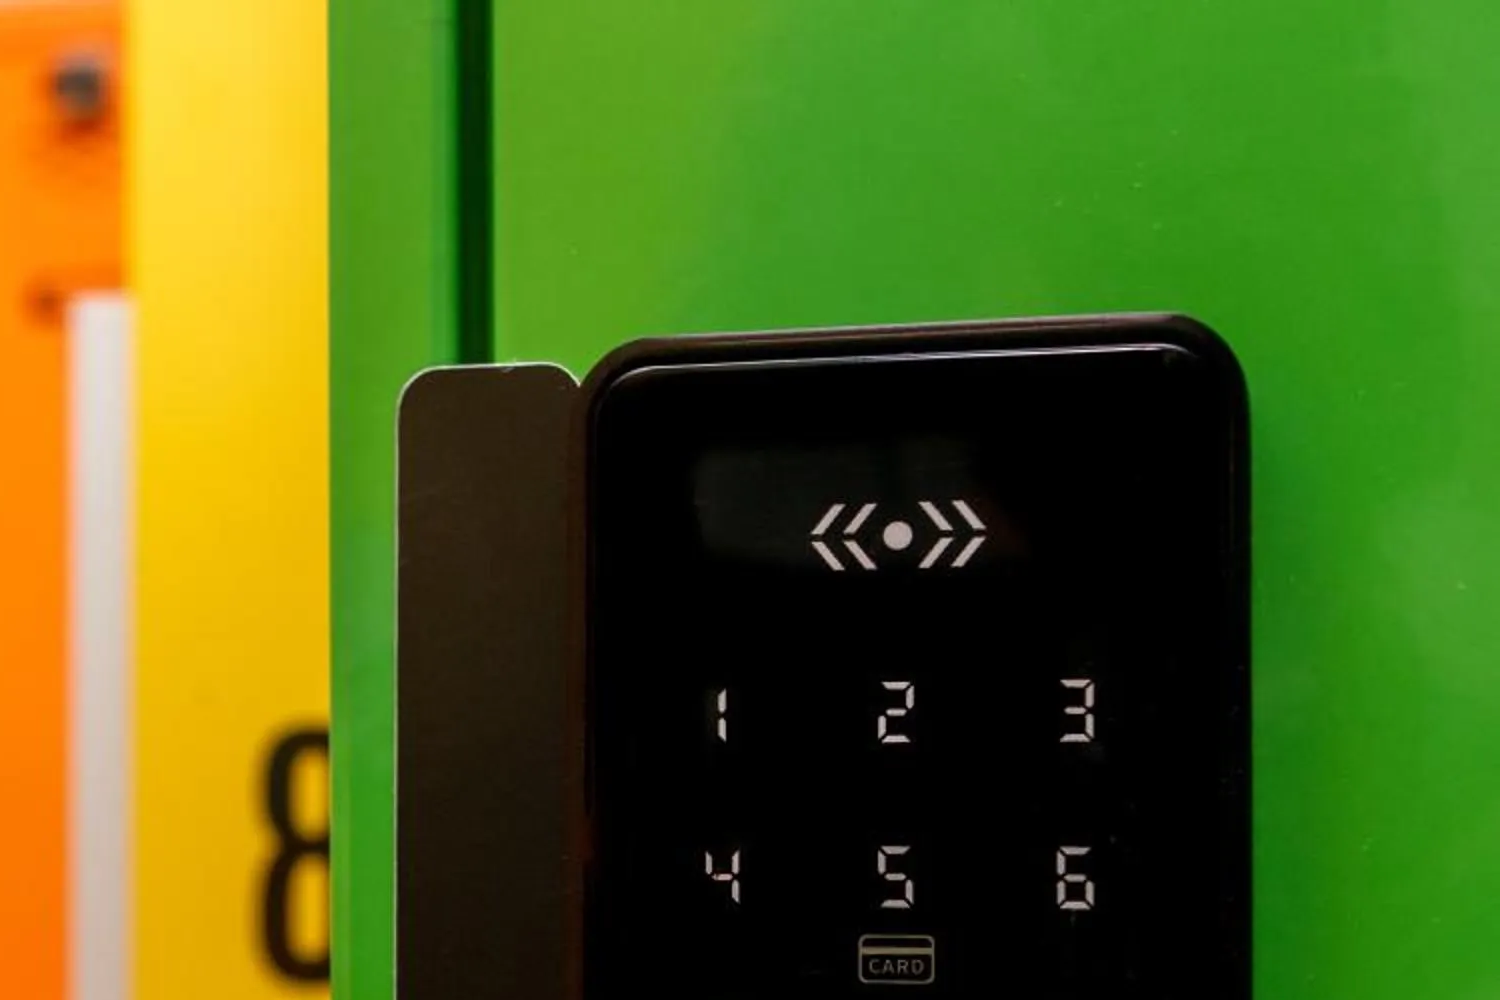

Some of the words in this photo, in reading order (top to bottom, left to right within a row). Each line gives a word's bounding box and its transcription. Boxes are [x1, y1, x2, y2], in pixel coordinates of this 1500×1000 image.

[716, 688, 728, 742] 1
[877, 680, 915, 744] 2
[1059, 679, 1096, 743] 3
[259, 725, 331, 985] 8
[705, 849, 741, 904] 4
[877, 845, 914, 909] 5
[1056, 846, 1095, 911] 6
[868, 957, 926, 976] CARD
